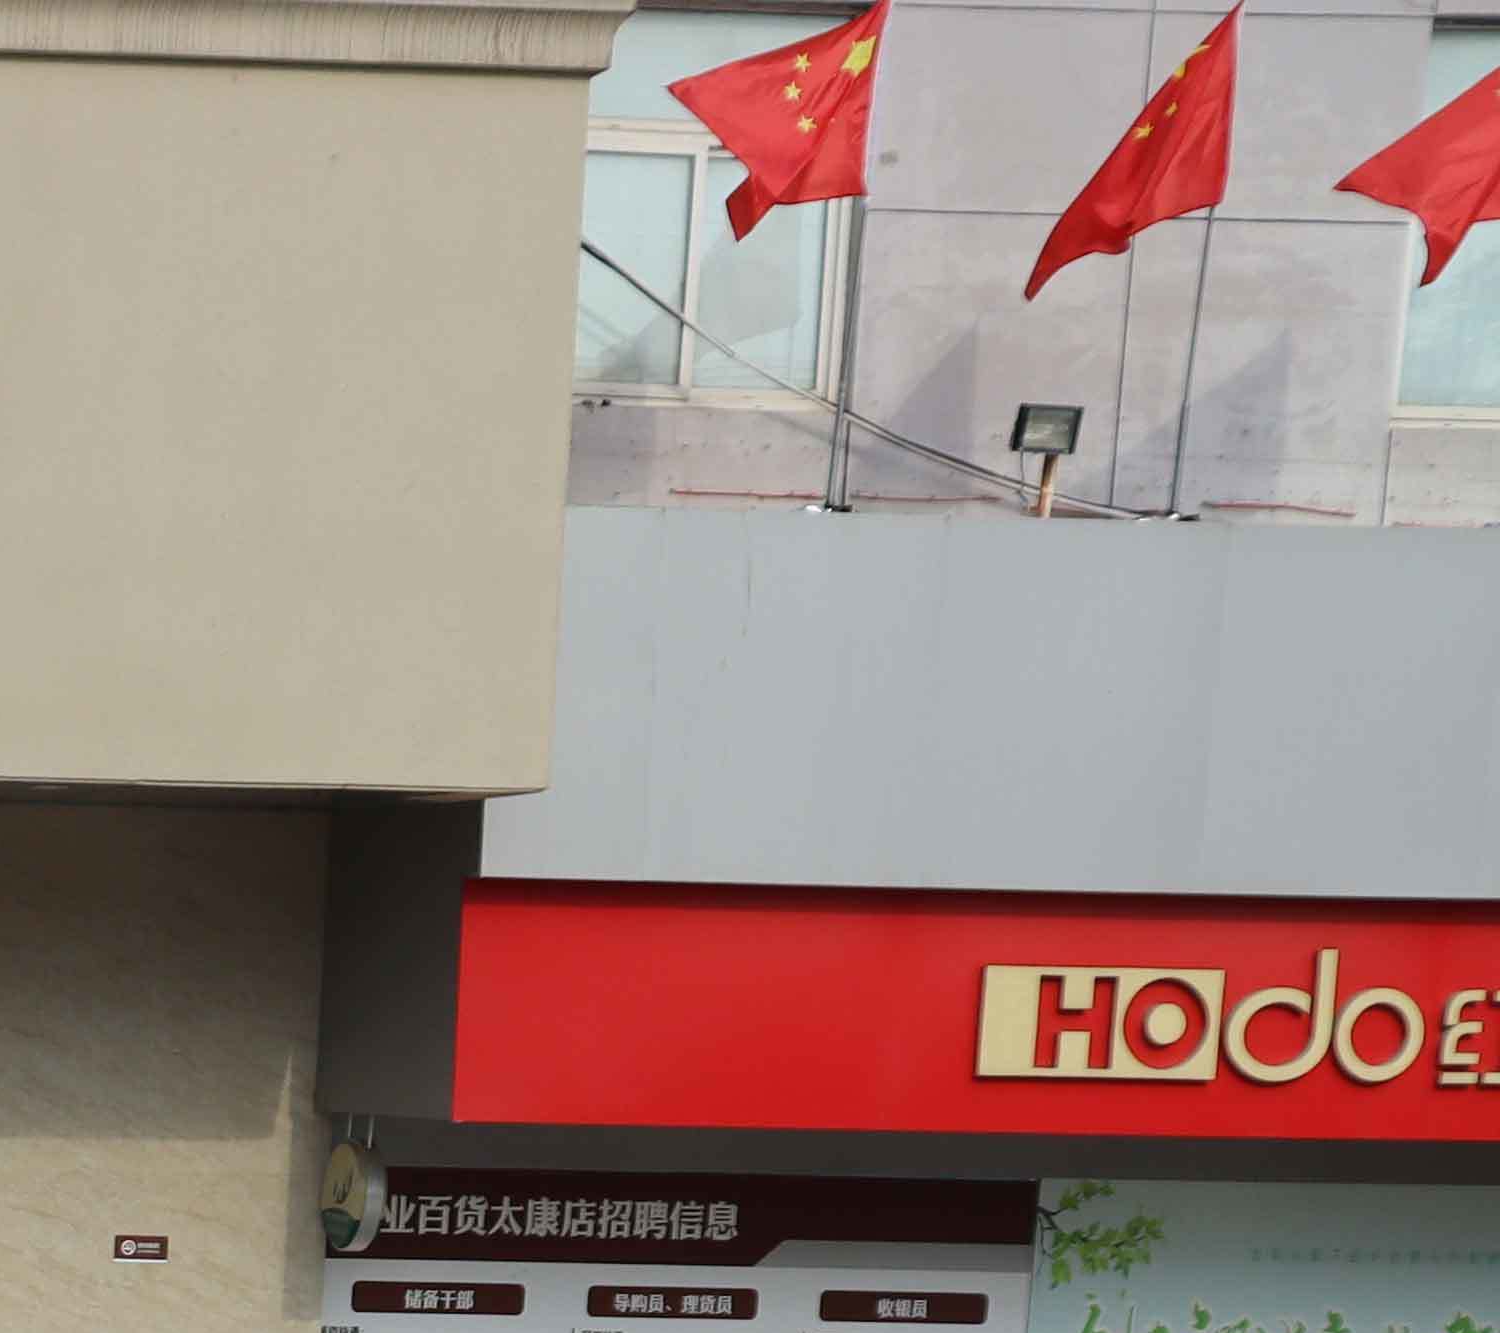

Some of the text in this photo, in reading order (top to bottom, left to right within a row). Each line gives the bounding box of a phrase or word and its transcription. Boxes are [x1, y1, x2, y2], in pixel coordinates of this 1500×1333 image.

[405, 1289, 475, 1311] 储备干部
[613, 1293, 733, 1316] 导购员、理货员
[876, 1298, 928, 1319] 收银员
